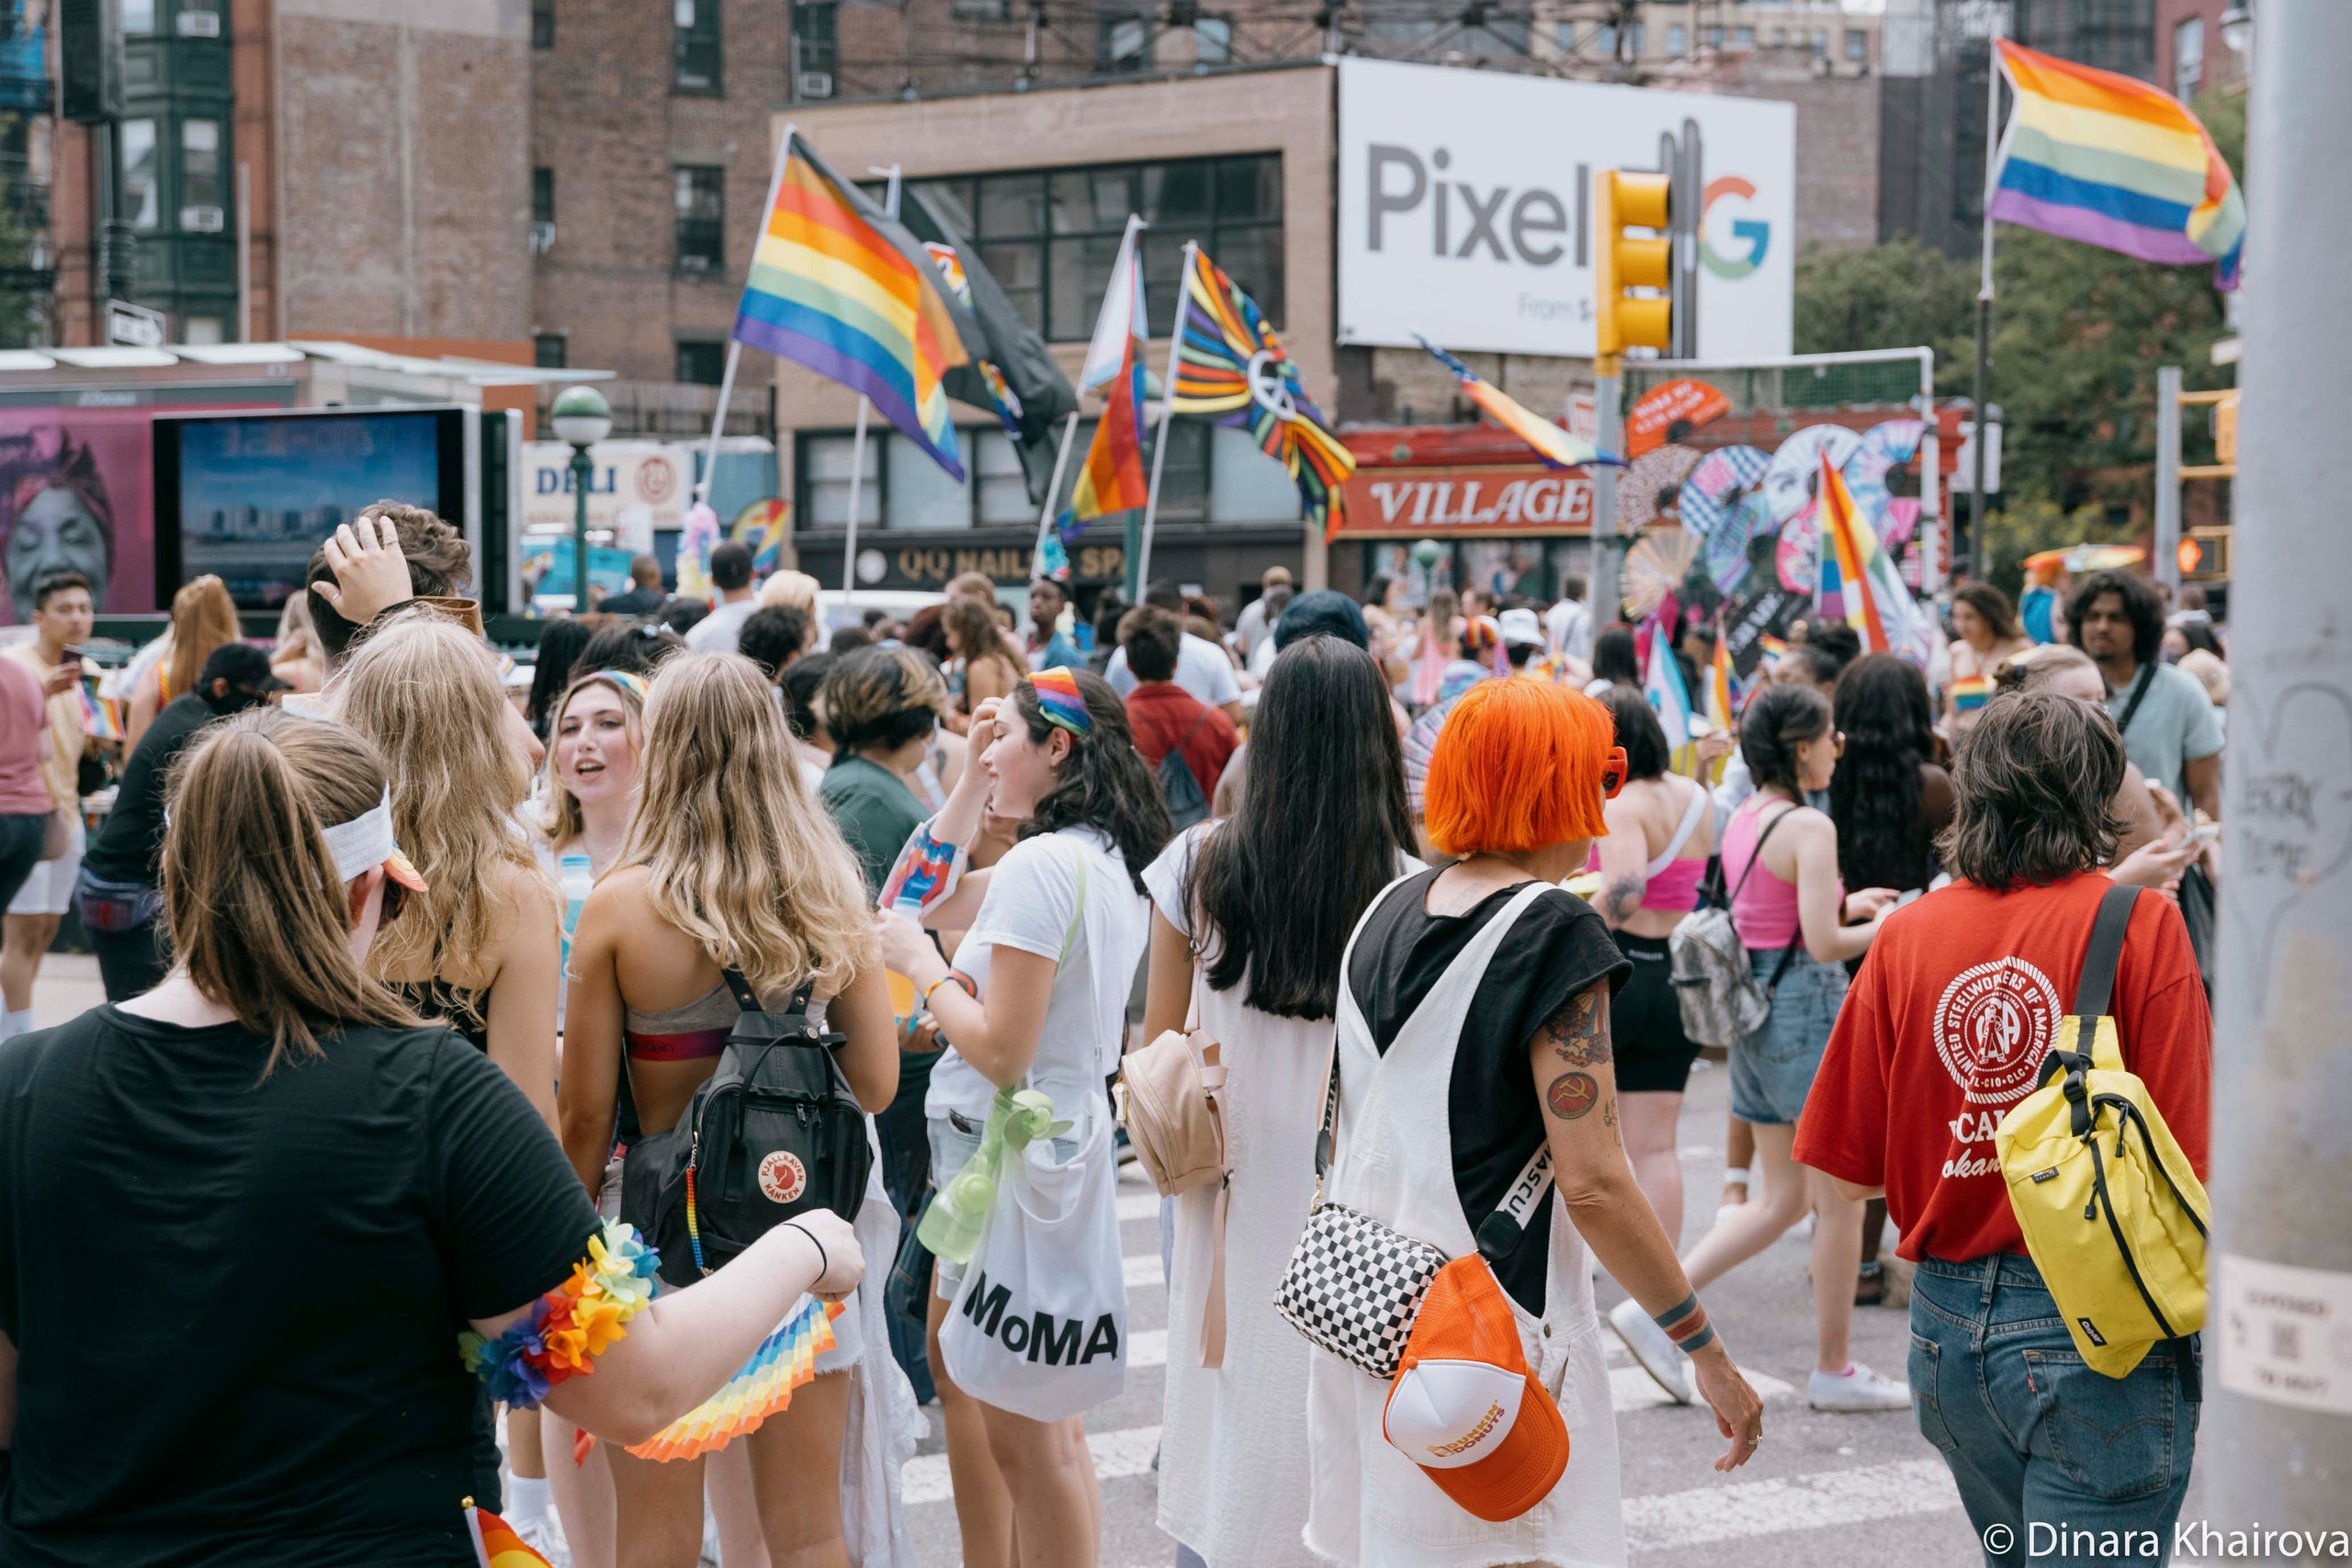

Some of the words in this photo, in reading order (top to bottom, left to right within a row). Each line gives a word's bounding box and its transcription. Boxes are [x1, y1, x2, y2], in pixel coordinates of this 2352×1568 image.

[1367, 143, 1589, 268] Pixel
[1370, 478, 1594, 525] VILLAGE
[898, 547, 949, 581] QQ
[2023, 987, 2042, 1005] OF
[2023, 1007, 2048, 1068] AMERICA
[963, 1269, 1118, 1366] MoMA
[1445, 1398, 1498, 1450] DUNKIN'
[1452, 1406, 1506, 1454] DONUTS
